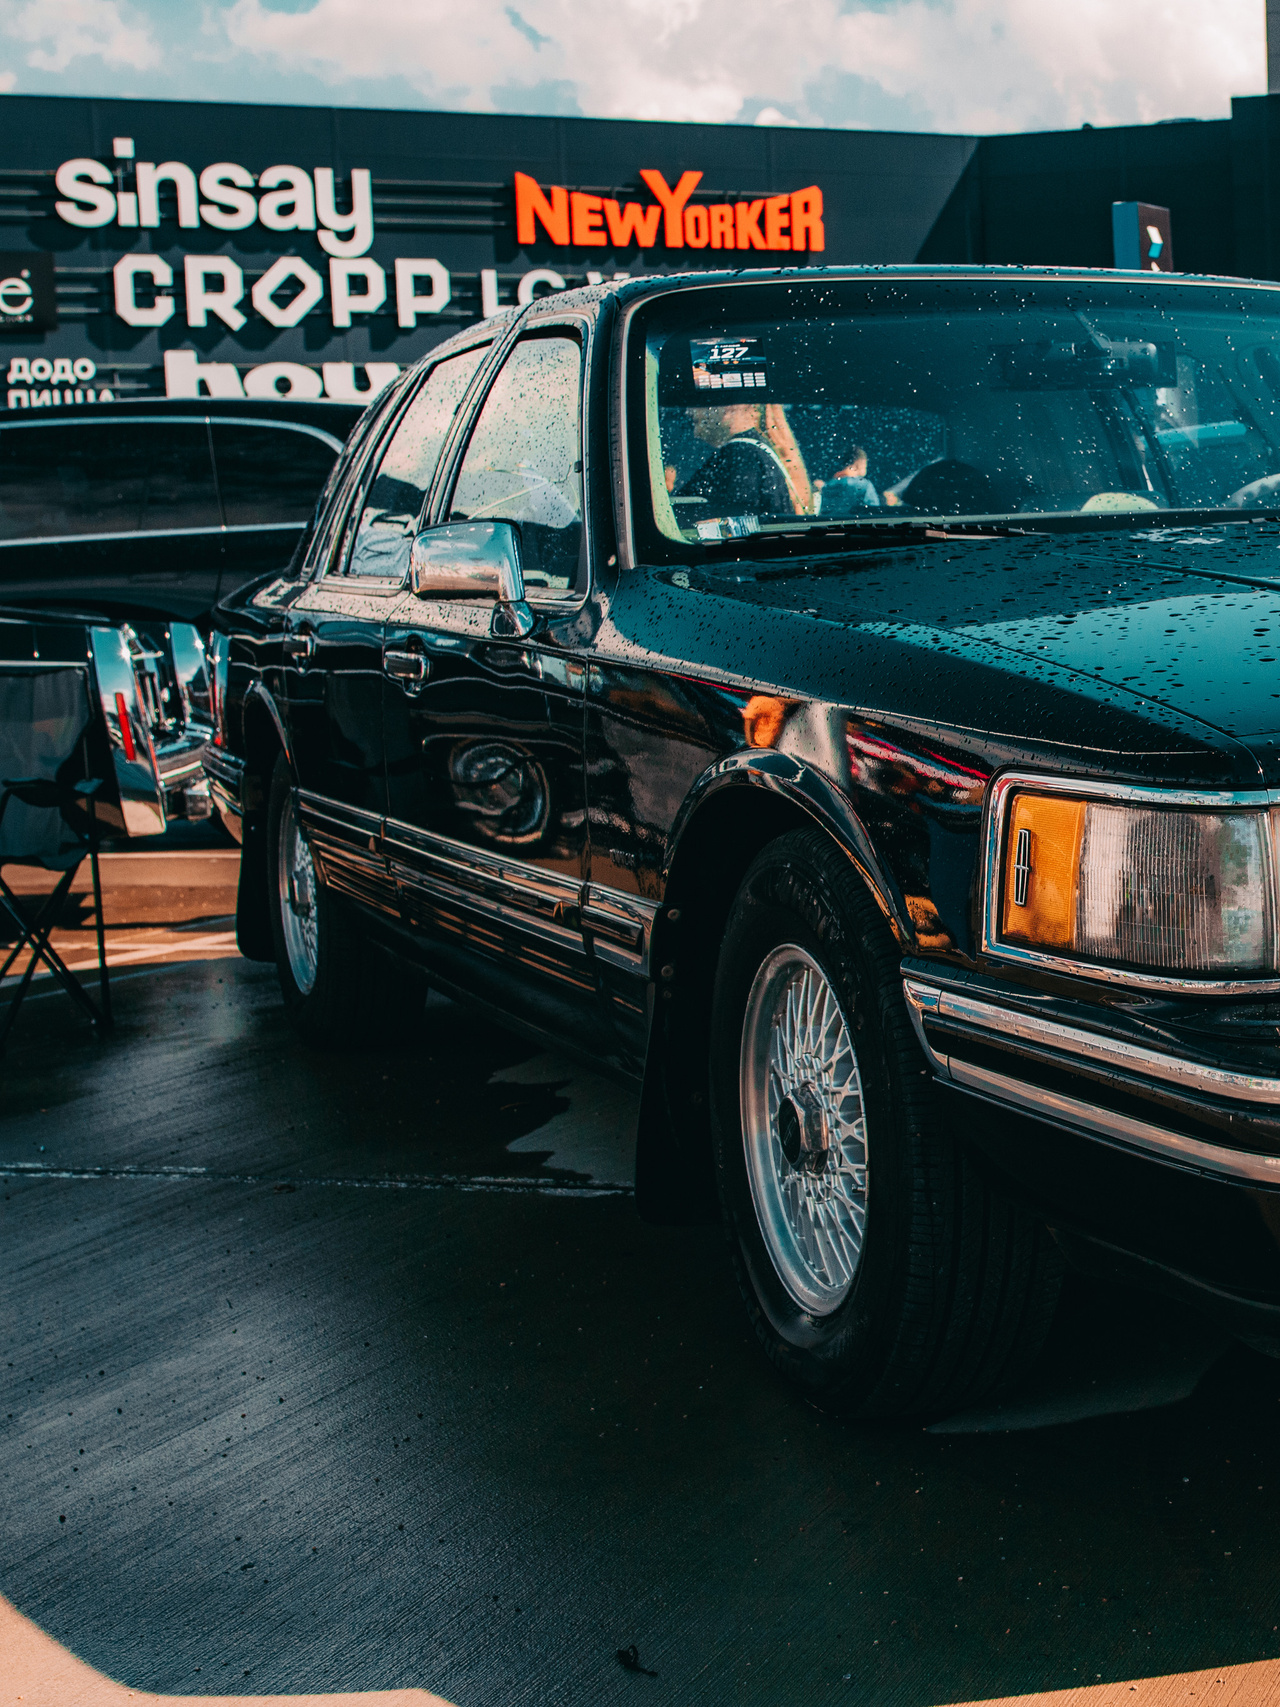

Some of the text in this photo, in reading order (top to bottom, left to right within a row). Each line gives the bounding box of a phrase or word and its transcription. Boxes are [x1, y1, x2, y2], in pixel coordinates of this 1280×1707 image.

[55, 137, 374, 257] sinsay
[113, 253, 451, 331] CROPP
[7, 357, 97, 385] ДОДО
[709, 346, 749, 360] 127
